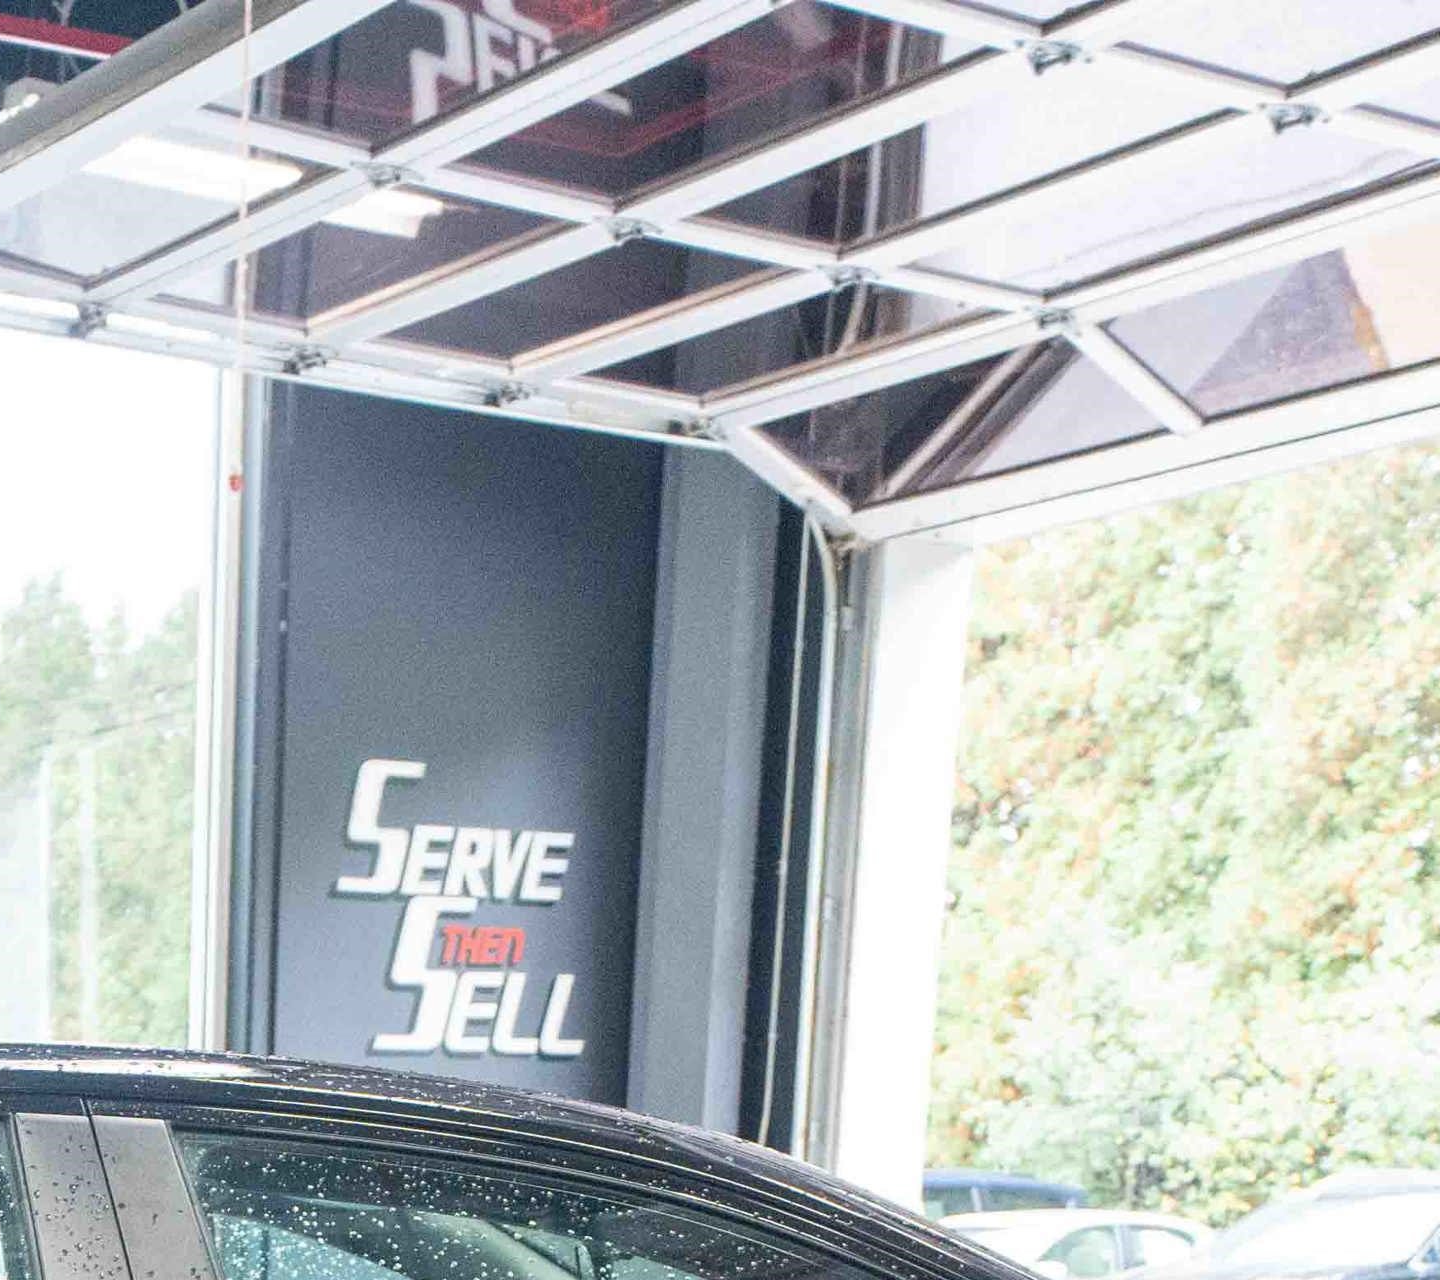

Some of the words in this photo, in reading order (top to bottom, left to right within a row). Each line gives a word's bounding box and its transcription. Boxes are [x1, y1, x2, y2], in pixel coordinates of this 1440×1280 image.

[336, 758, 575, 901] SERVE
[371, 895, 585, 1057] SELL
[440, 922, 526, 966] THEN
